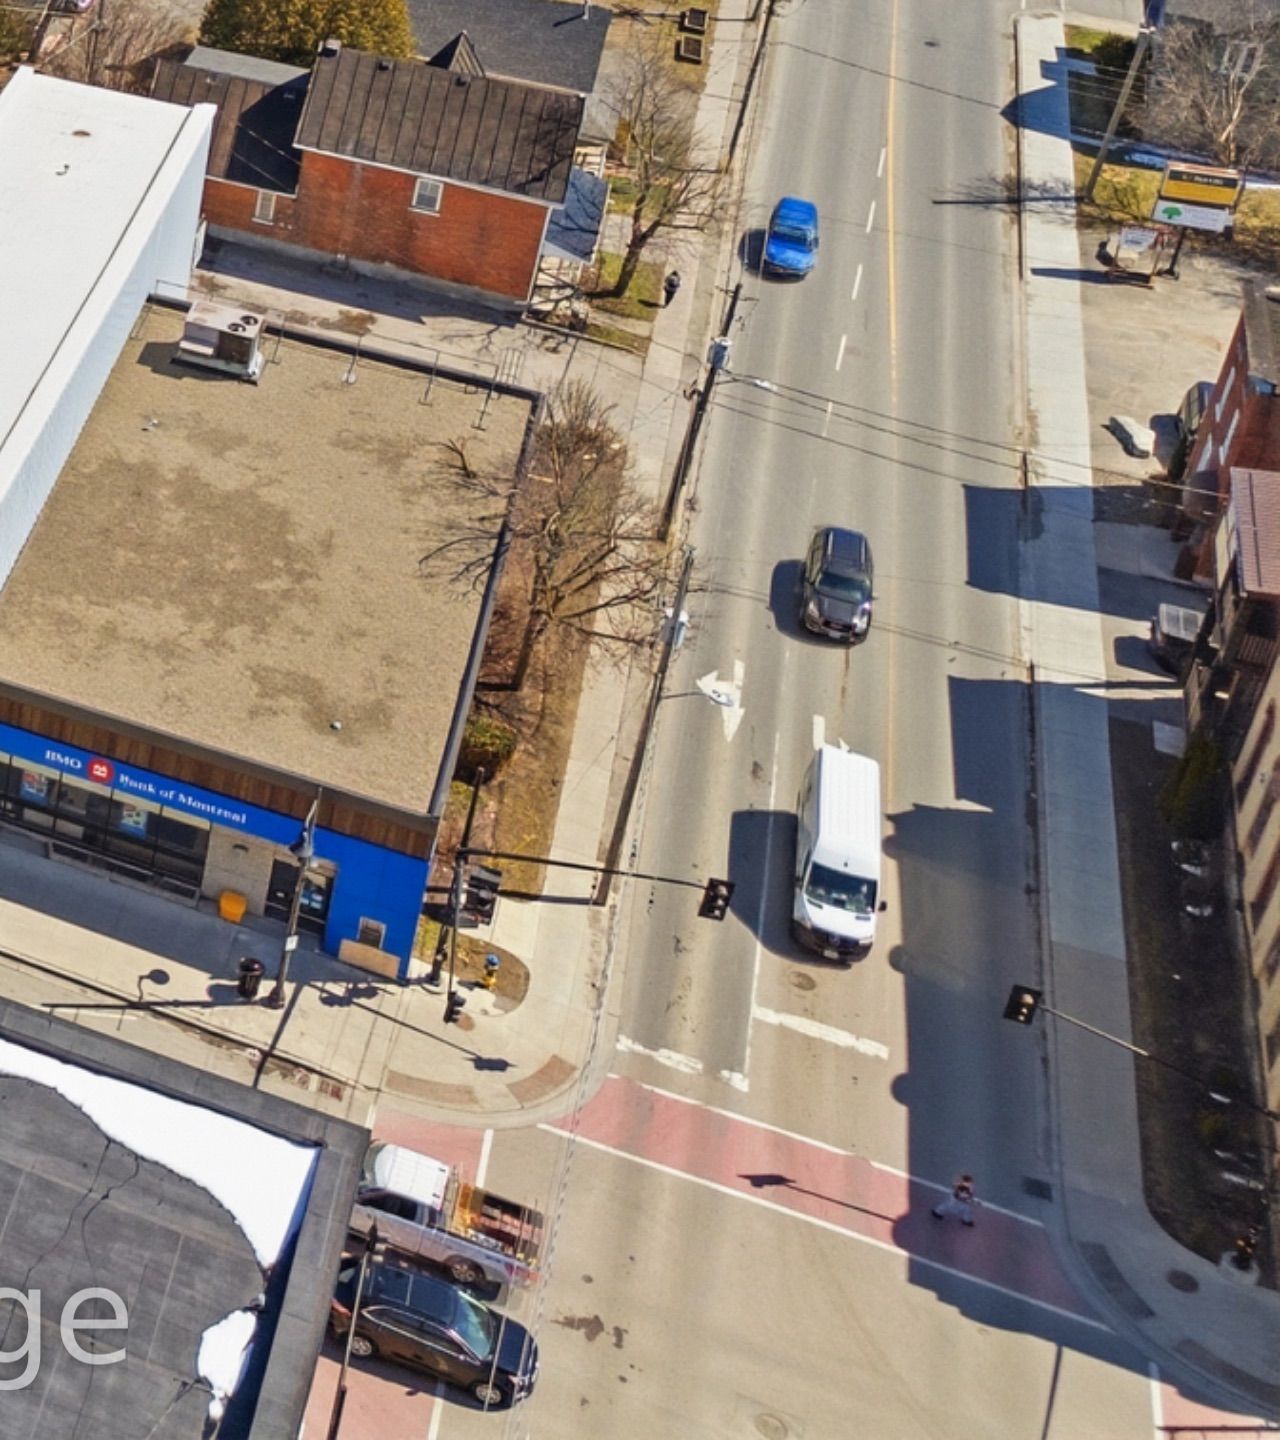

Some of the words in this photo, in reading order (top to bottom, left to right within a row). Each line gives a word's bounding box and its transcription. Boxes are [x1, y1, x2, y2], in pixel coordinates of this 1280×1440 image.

[44, 749, 83, 770] BMO
[119, 773, 156, 795] Bank
[159, 789, 176, 801] of
[178, 793, 247, 825] Montreal
